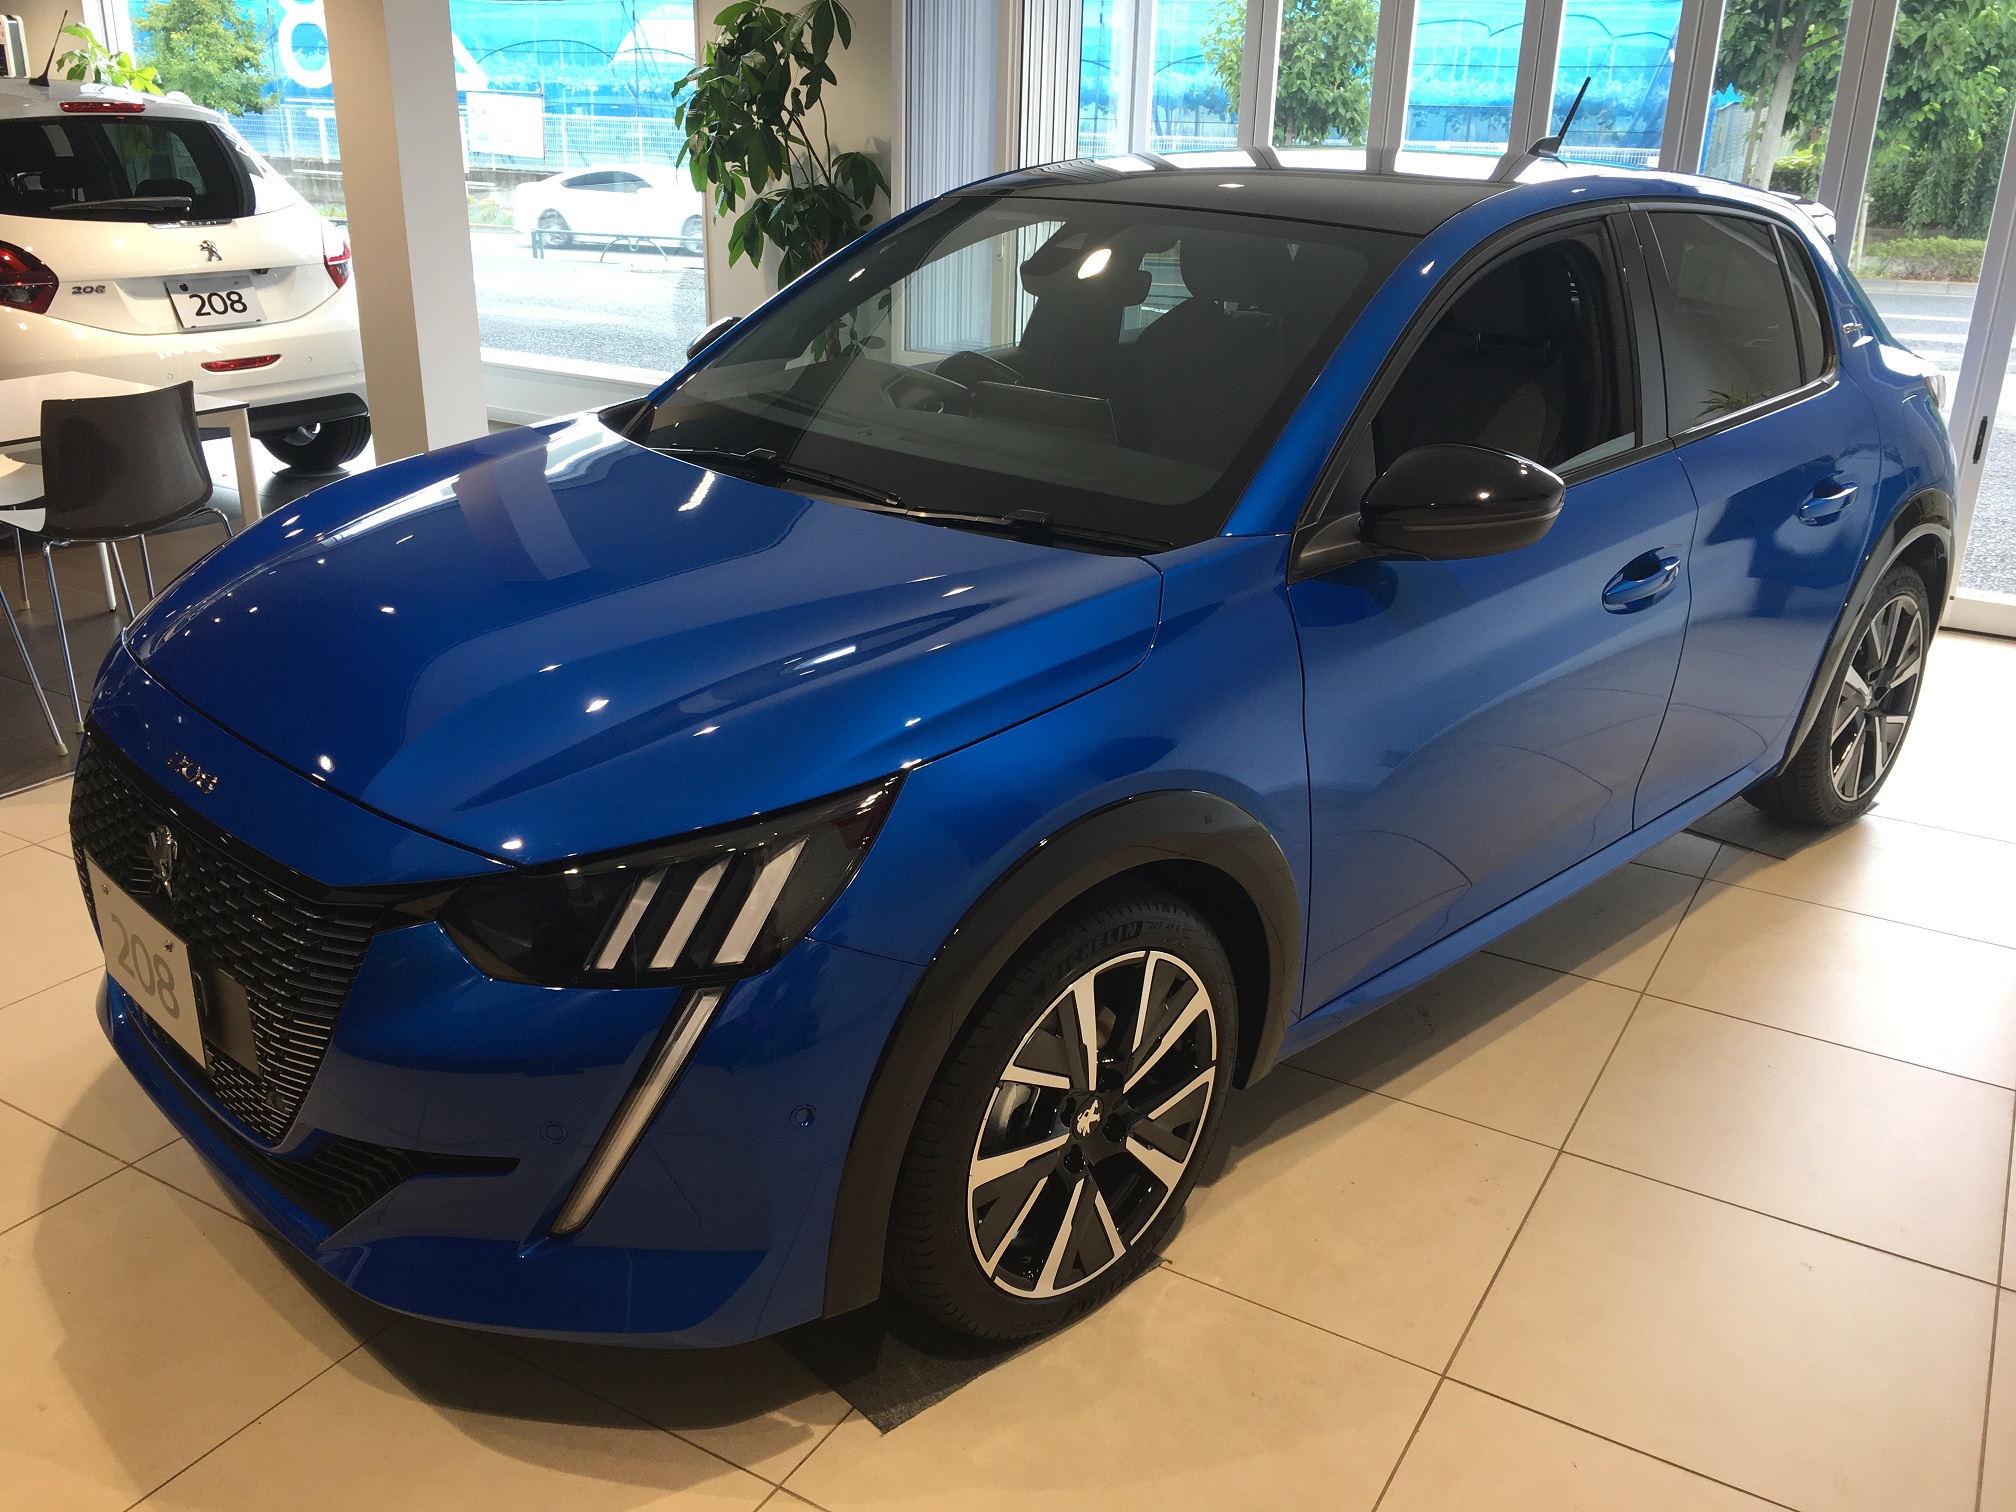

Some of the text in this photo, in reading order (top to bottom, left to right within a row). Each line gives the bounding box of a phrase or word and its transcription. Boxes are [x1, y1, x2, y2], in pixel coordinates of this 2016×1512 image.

[71, 284, 106, 295] 208
[188, 290, 248, 317] 208
[110, 912, 180, 1020] 208
